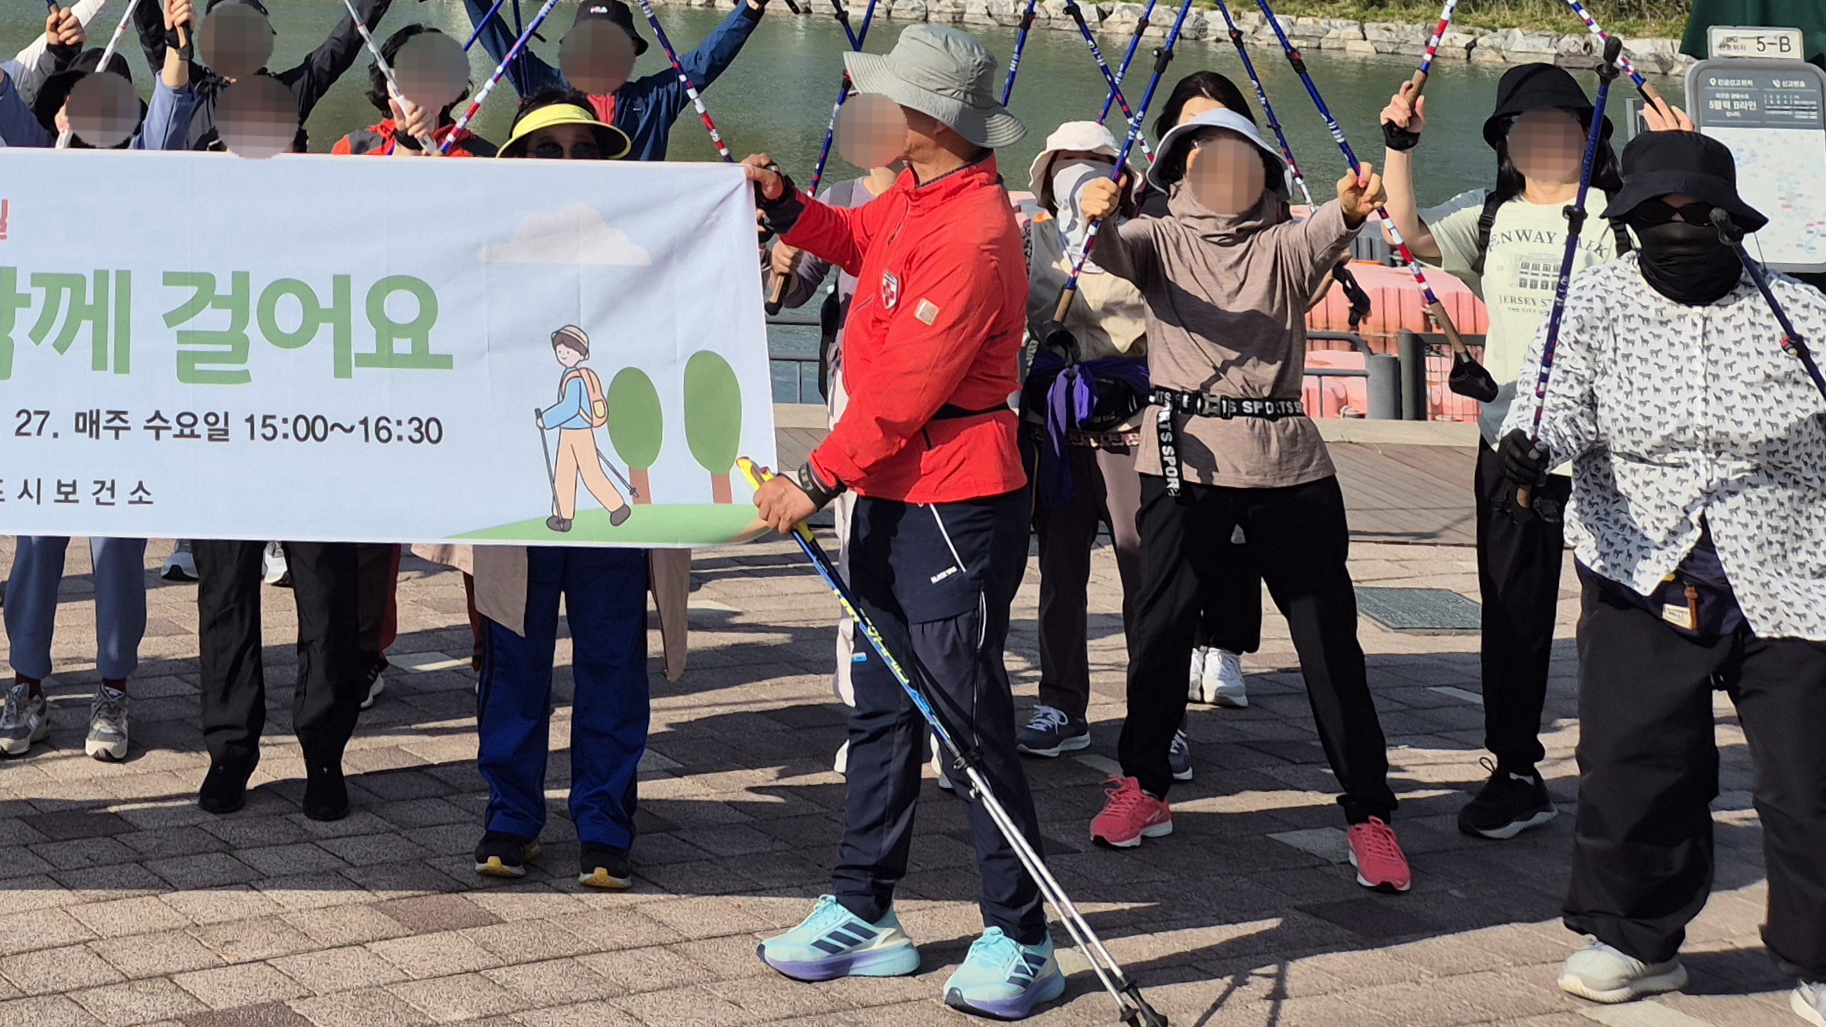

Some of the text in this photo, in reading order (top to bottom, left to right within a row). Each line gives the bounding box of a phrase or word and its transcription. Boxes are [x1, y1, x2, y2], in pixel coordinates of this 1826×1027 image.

[1756, 36, 1792, 53] 5-B
[1498, 294, 1536, 306] JERSEY
[161, 269, 454, 385] 걸어요
[14, 408, 59, 439] 27.
[74, 408, 132, 441] 매주
[143, 409, 231, 443] 수요일
[243, 413, 444, 446] 15:00~16:30
